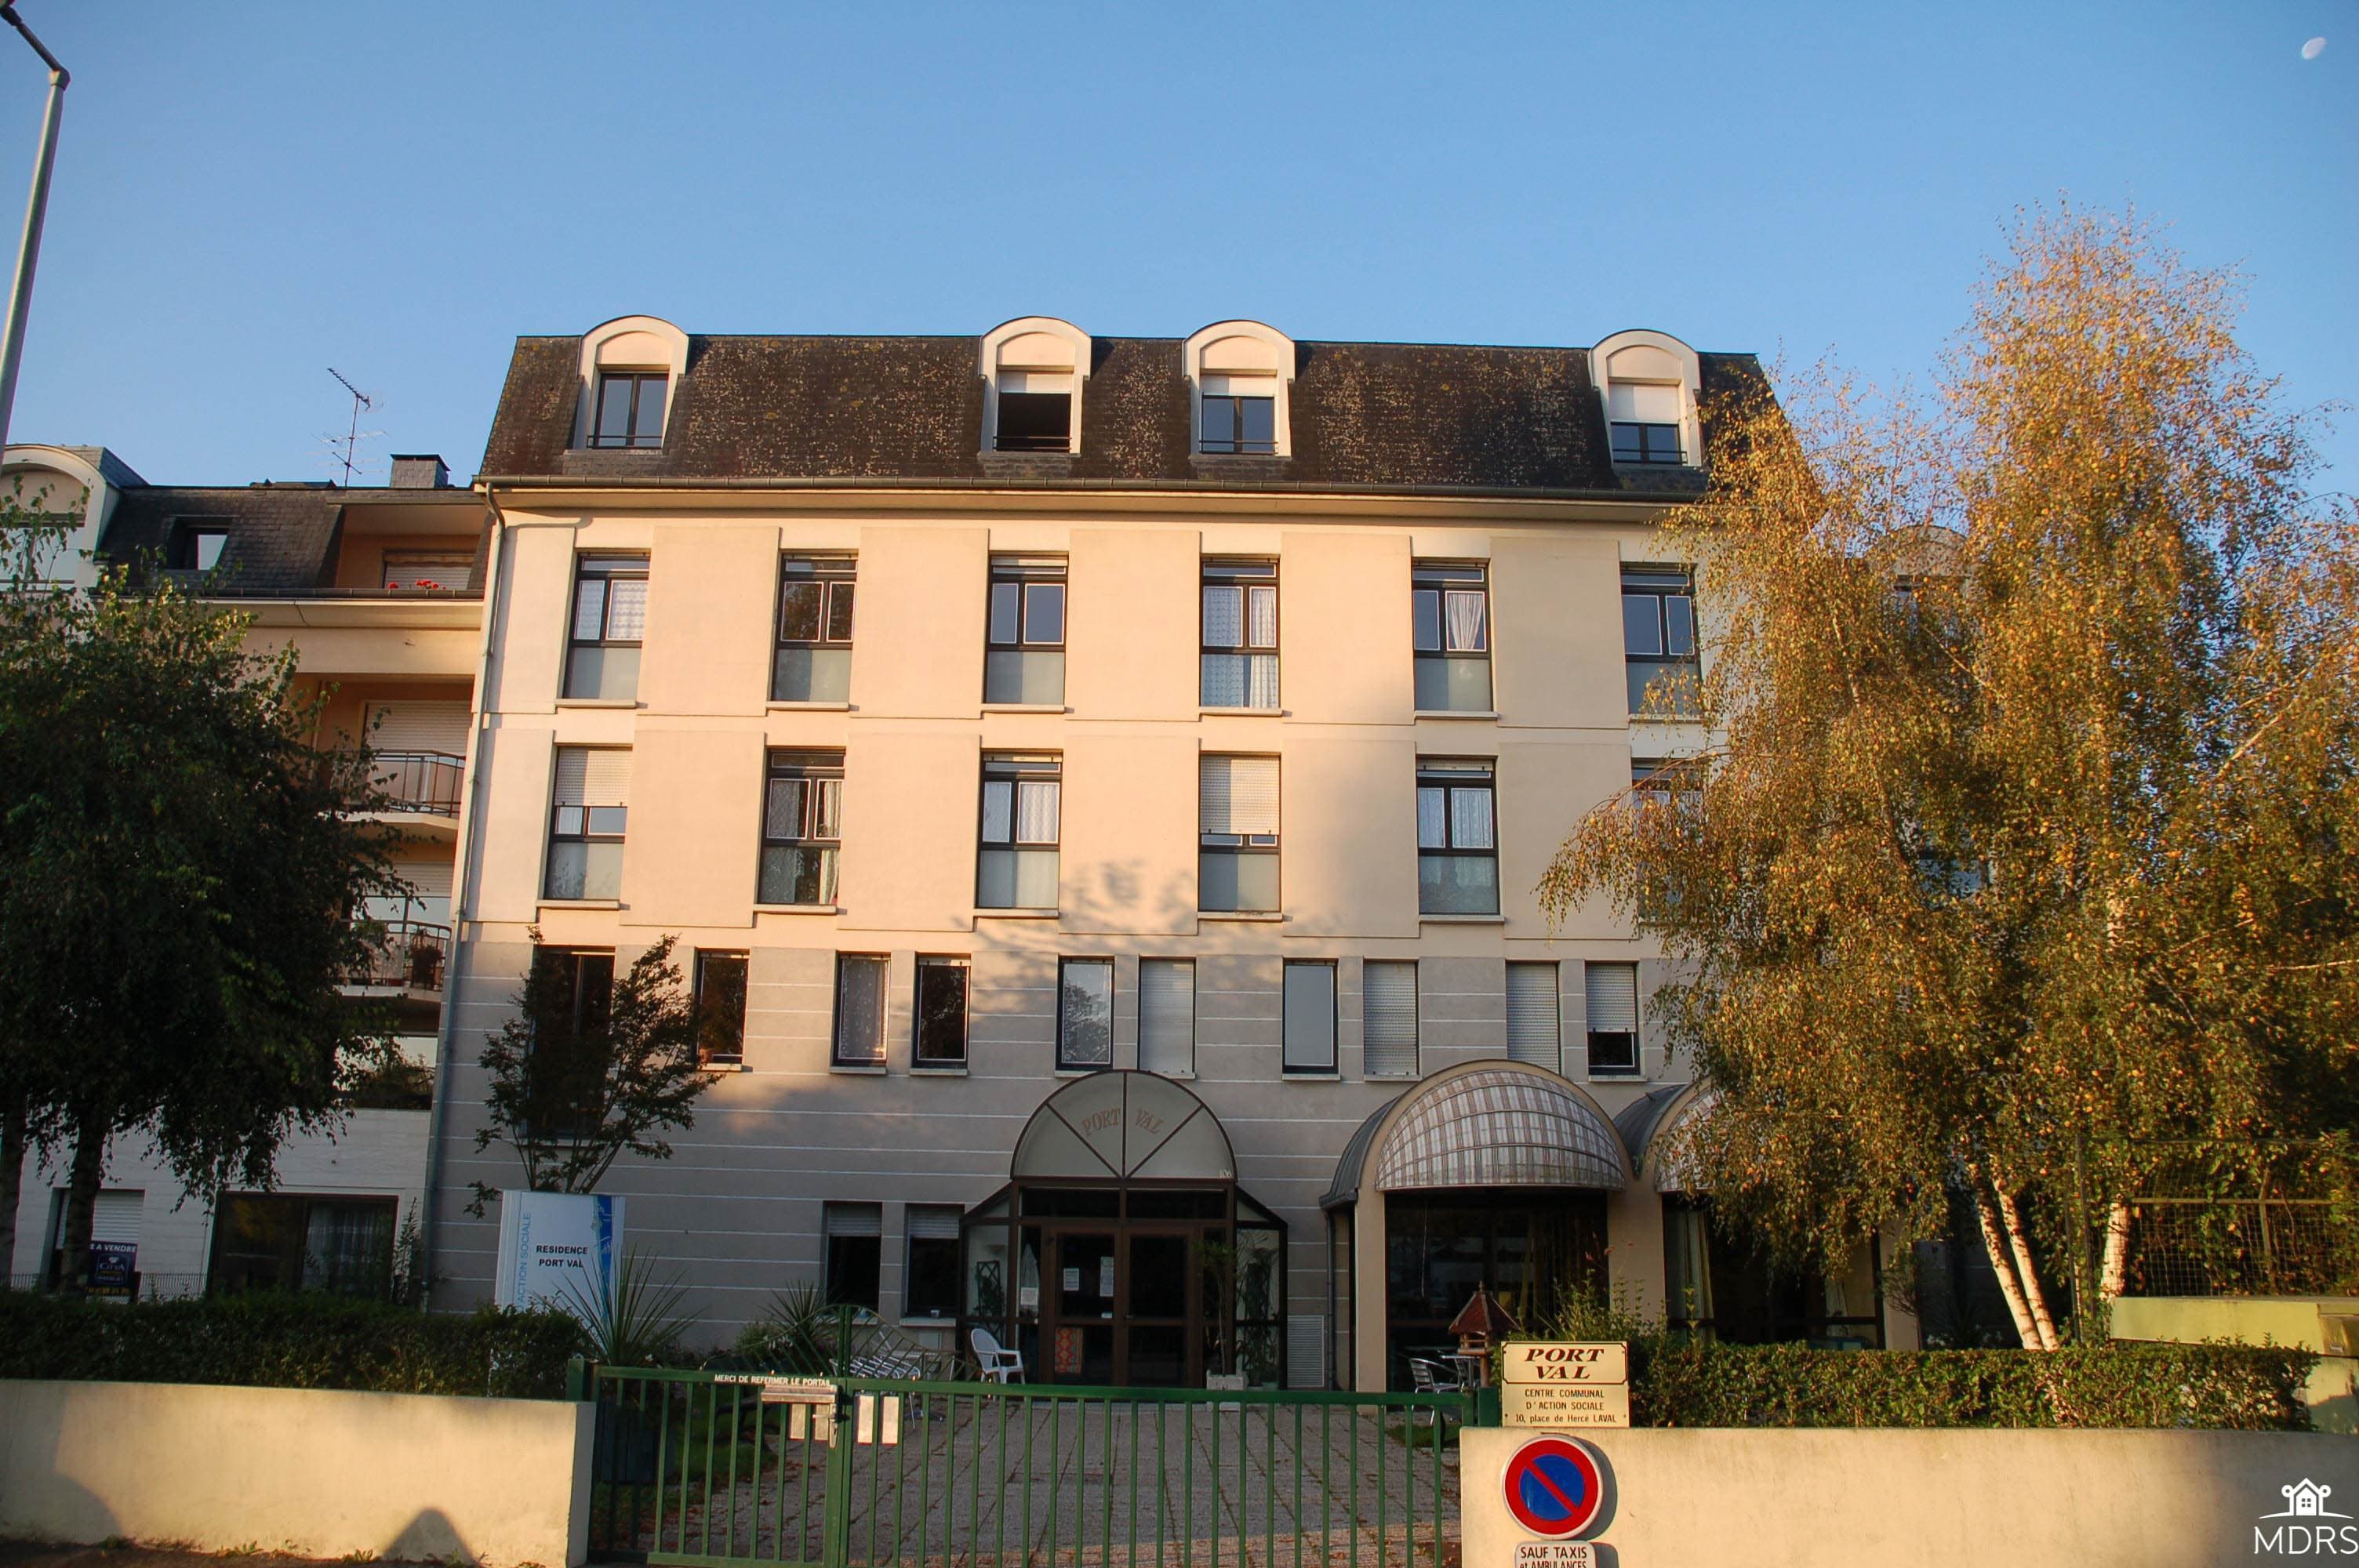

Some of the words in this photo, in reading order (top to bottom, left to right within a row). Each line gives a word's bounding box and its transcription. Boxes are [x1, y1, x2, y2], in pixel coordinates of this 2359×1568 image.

[1081, 1106, 1121, 1135] PORT
[1136, 1107, 1165, 1134] VAL
[521, 1212, 531, 1260] SOCIALE
[536, 1244, 588, 1255] RESIDENCE
[539, 1258, 565, 1267] PORT
[567, 1258, 583, 1268] VAL
[1525, 1348, 1605, 1362] PORT
[1536, 1366, 1590, 1379] VAL
[714, 1374, 736, 1383] MERCI
[751, 1376, 788, 1385] REFERMER
[1525, 1388, 1555, 1398] CENTRE
[1559, 1389, 1605, 1398] COMMUNAL
[1571, 1401, 1605, 1410] SOCIALE
[1515, 1414, 1526, 1423] 10,
[1529, 1414, 1550, 1425] place
[1593, 1414, 1617, 1423] LAVAL
[1521, 1546, 1548, 1559] SAUF
[1554, 1546, 1587, 1559] TAXIS
